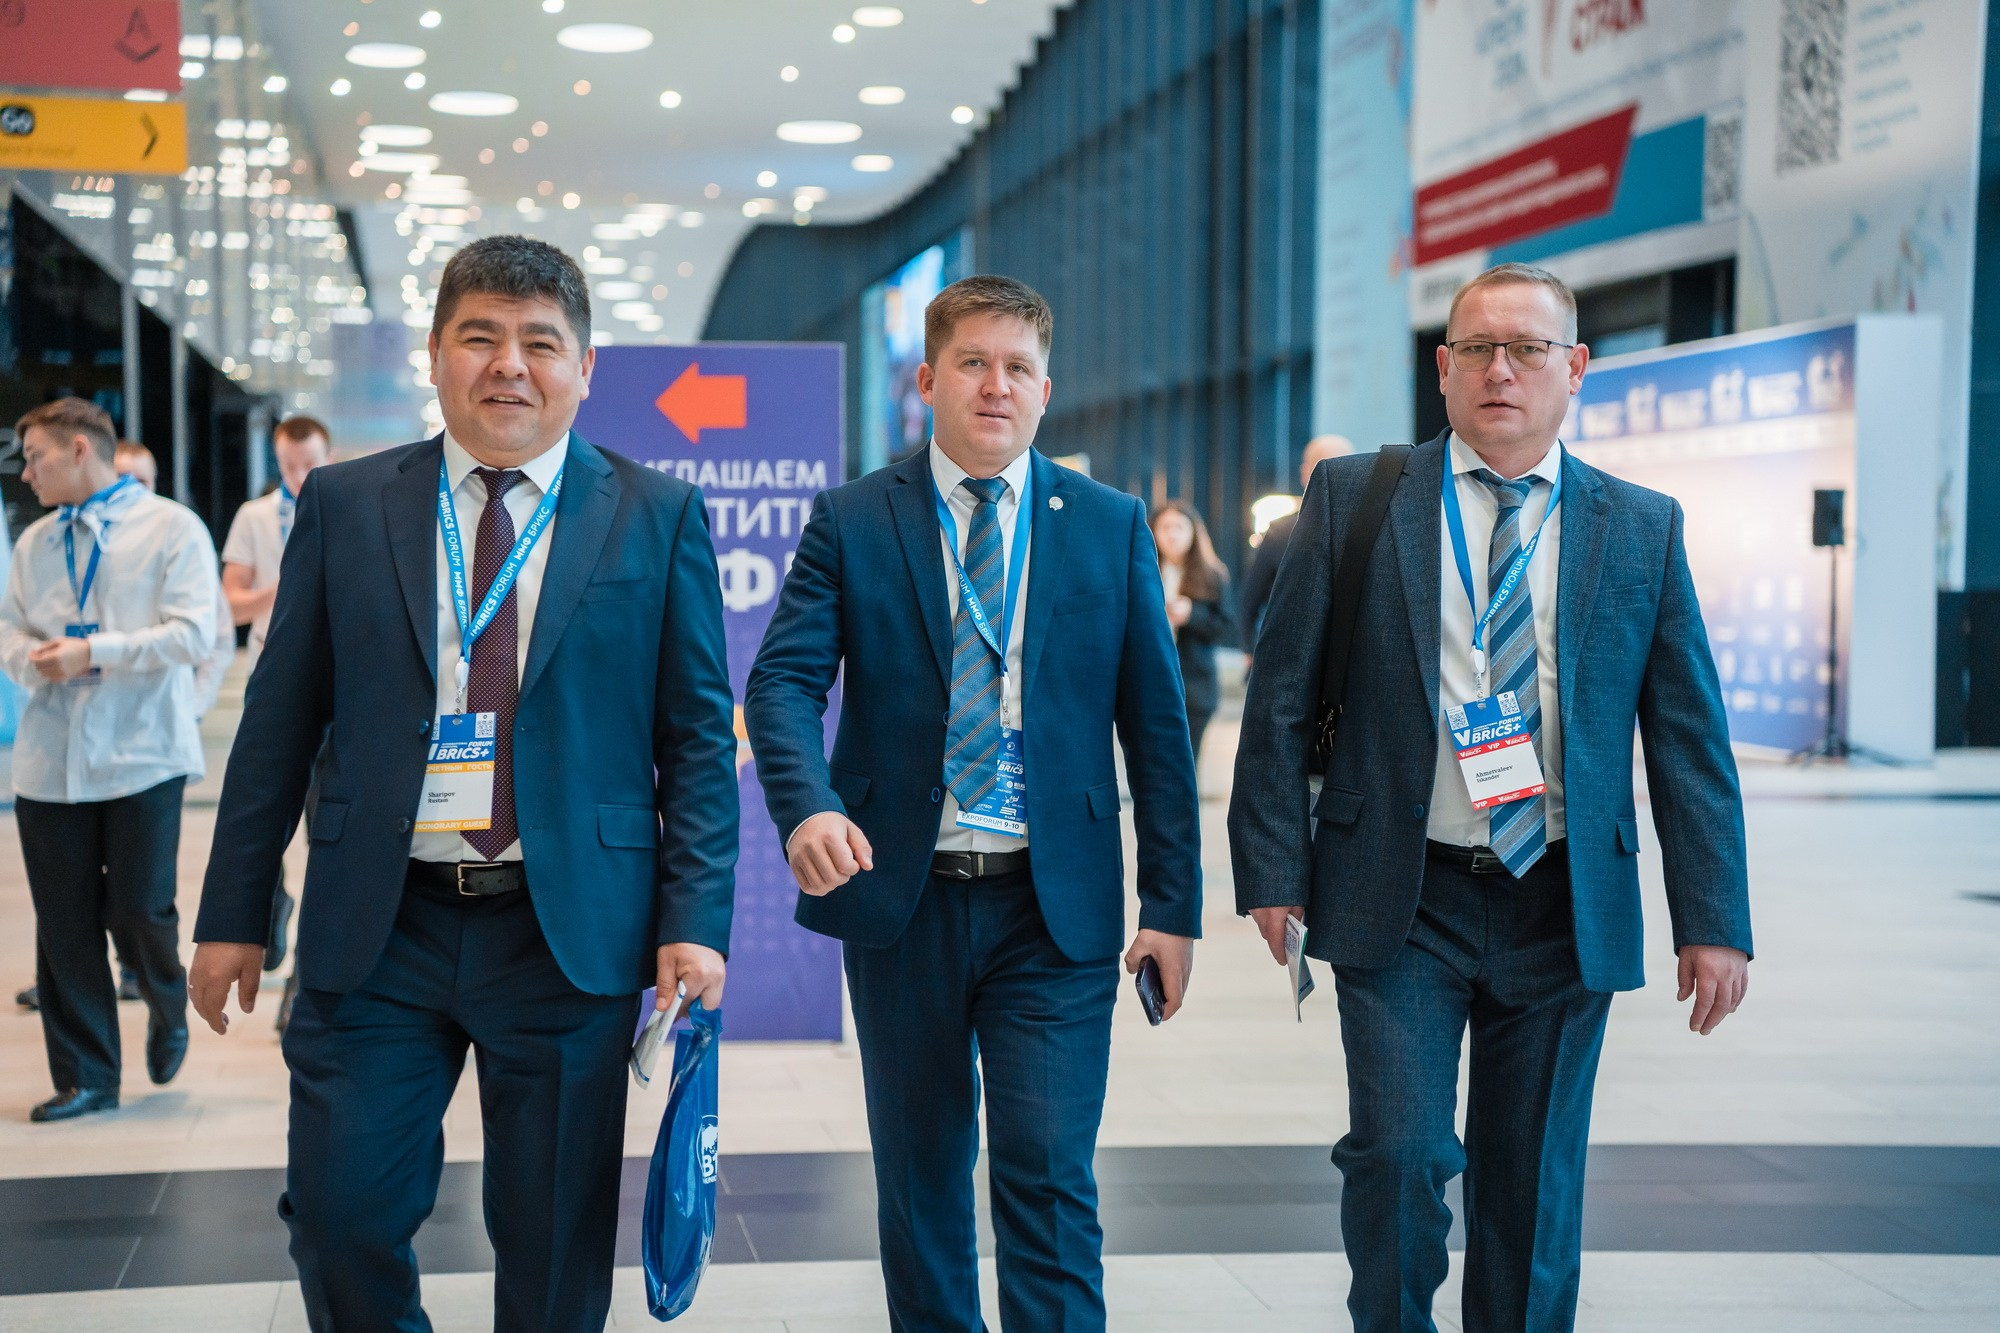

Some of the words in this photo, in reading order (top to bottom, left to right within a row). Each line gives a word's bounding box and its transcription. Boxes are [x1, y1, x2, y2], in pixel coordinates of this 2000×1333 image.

[633, 459, 827, 489] ГЛАШАЕМ
[439, 491, 455, 529] IMBRICS
[447, 531, 461, 567] FORUM
[513, 536, 532, 561] ММФ
[527, 506, 550, 537] БРИКС
[470, 597, 497, 637] IMBRICS
[492, 562, 517, 598] FORUM
[1483, 588, 1510, 624] IMBRICS
[1505, 558, 1526, 589] FORUM
[967, 596, 982, 621] ММФ
[1498, 716, 1521, 726] FORUM
[1487, 742, 1501, 750] VIP
[1475, 800, 1488, 808] VIP
[1531, 785, 1545, 794] VIP
[962, 813, 1002, 825] EXPOFORUM
